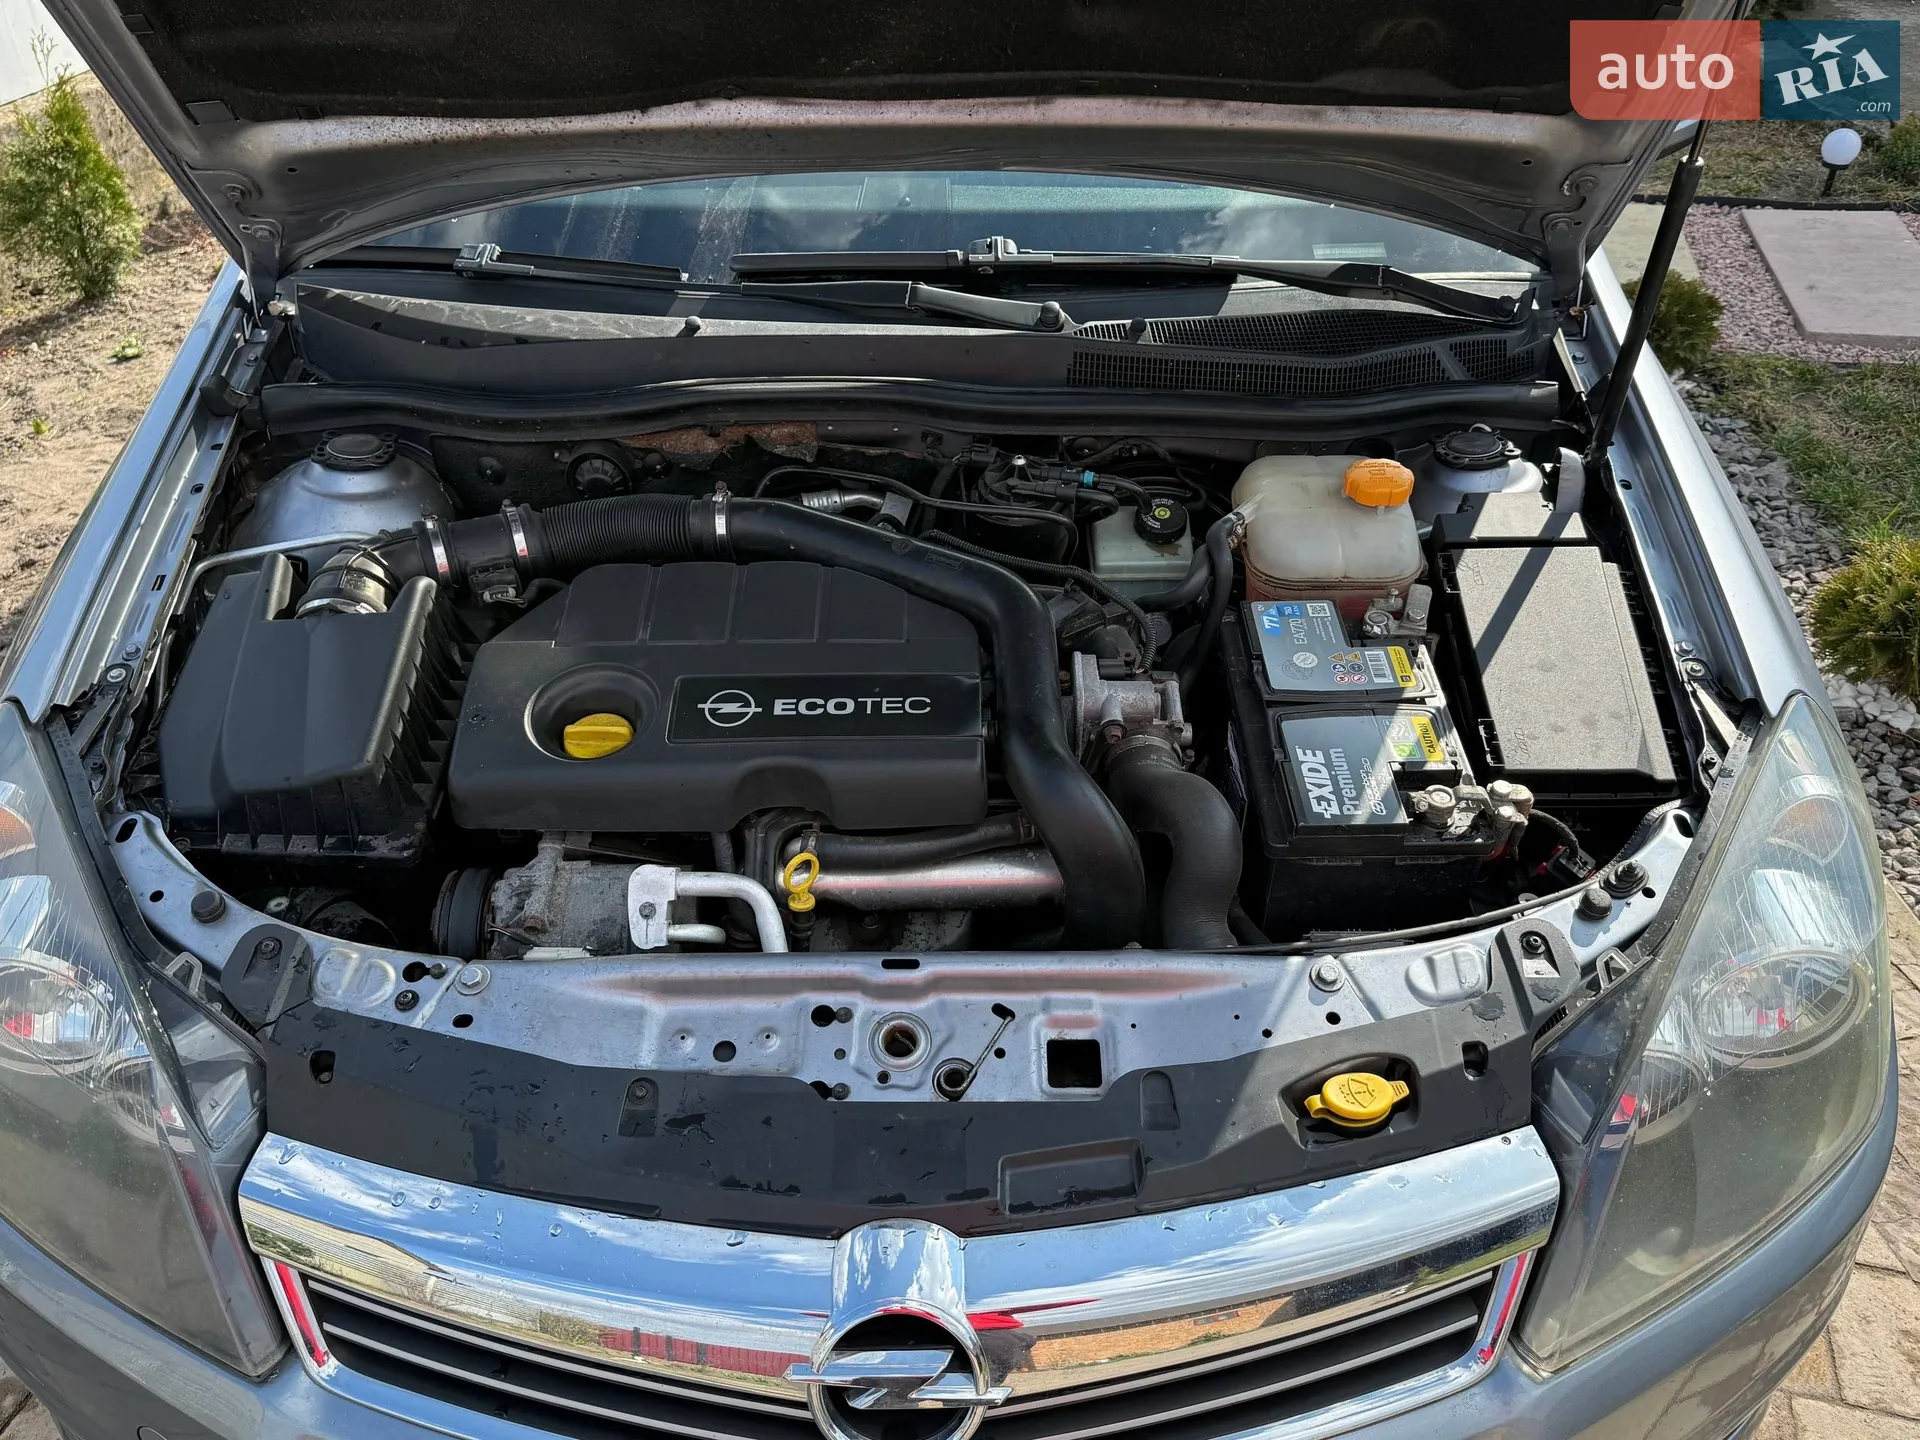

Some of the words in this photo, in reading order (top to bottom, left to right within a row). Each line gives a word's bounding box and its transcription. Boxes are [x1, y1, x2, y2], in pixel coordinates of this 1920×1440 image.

[1263, 615, 1280, 630] 77
[1288, 618, 1308, 645] EA770
[773, 696, 932, 716] ECOTEC
[1417, 722, 1436, 754] CAUTION
[1295, 748, 1339, 819] EXIDE
[1329, 748, 1363, 817] Premium
